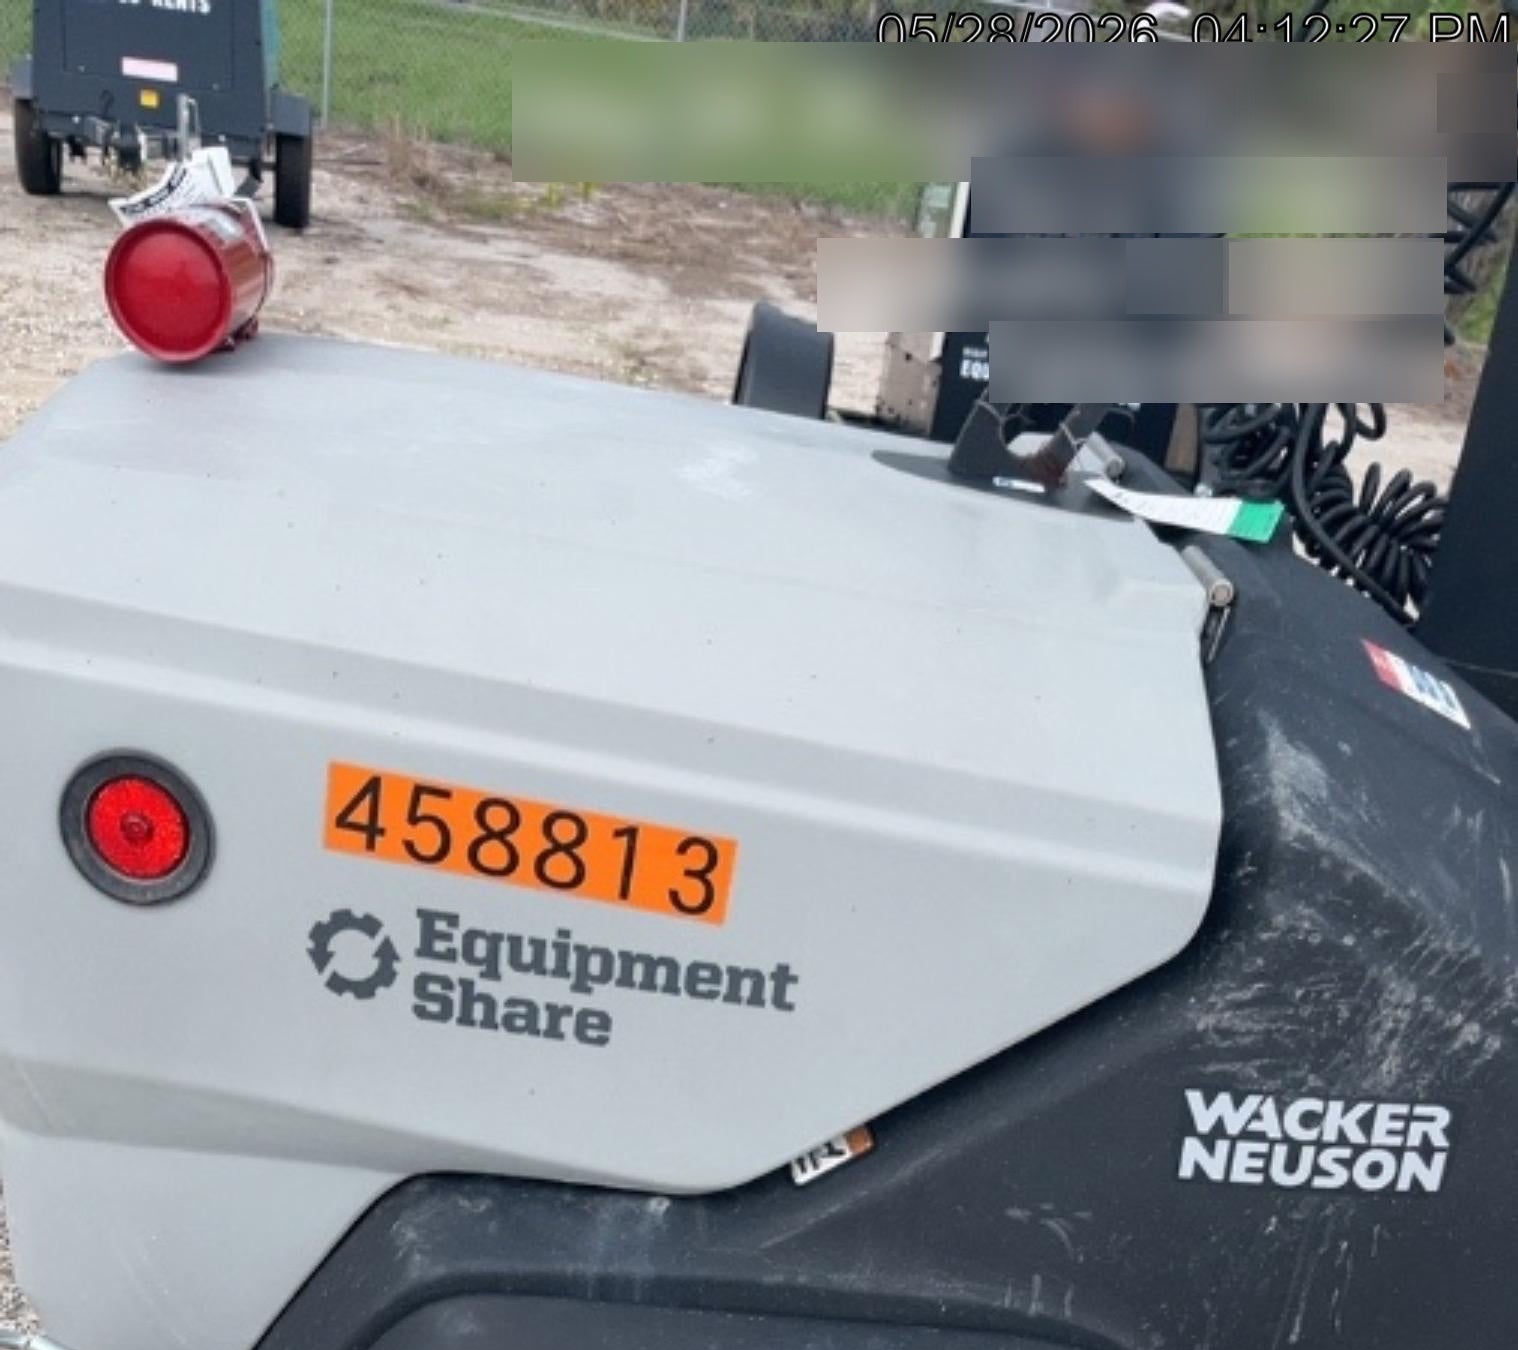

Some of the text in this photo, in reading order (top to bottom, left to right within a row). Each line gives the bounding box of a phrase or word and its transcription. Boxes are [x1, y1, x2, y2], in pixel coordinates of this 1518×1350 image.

[335, 775, 719, 915] 458813
[415, 908, 798, 1011] Equipment
[412, 972, 613, 1046] Share
[1184, 1088, 1451, 1147] WACKER
[1178, 1136, 1447, 1192] NEUSON
